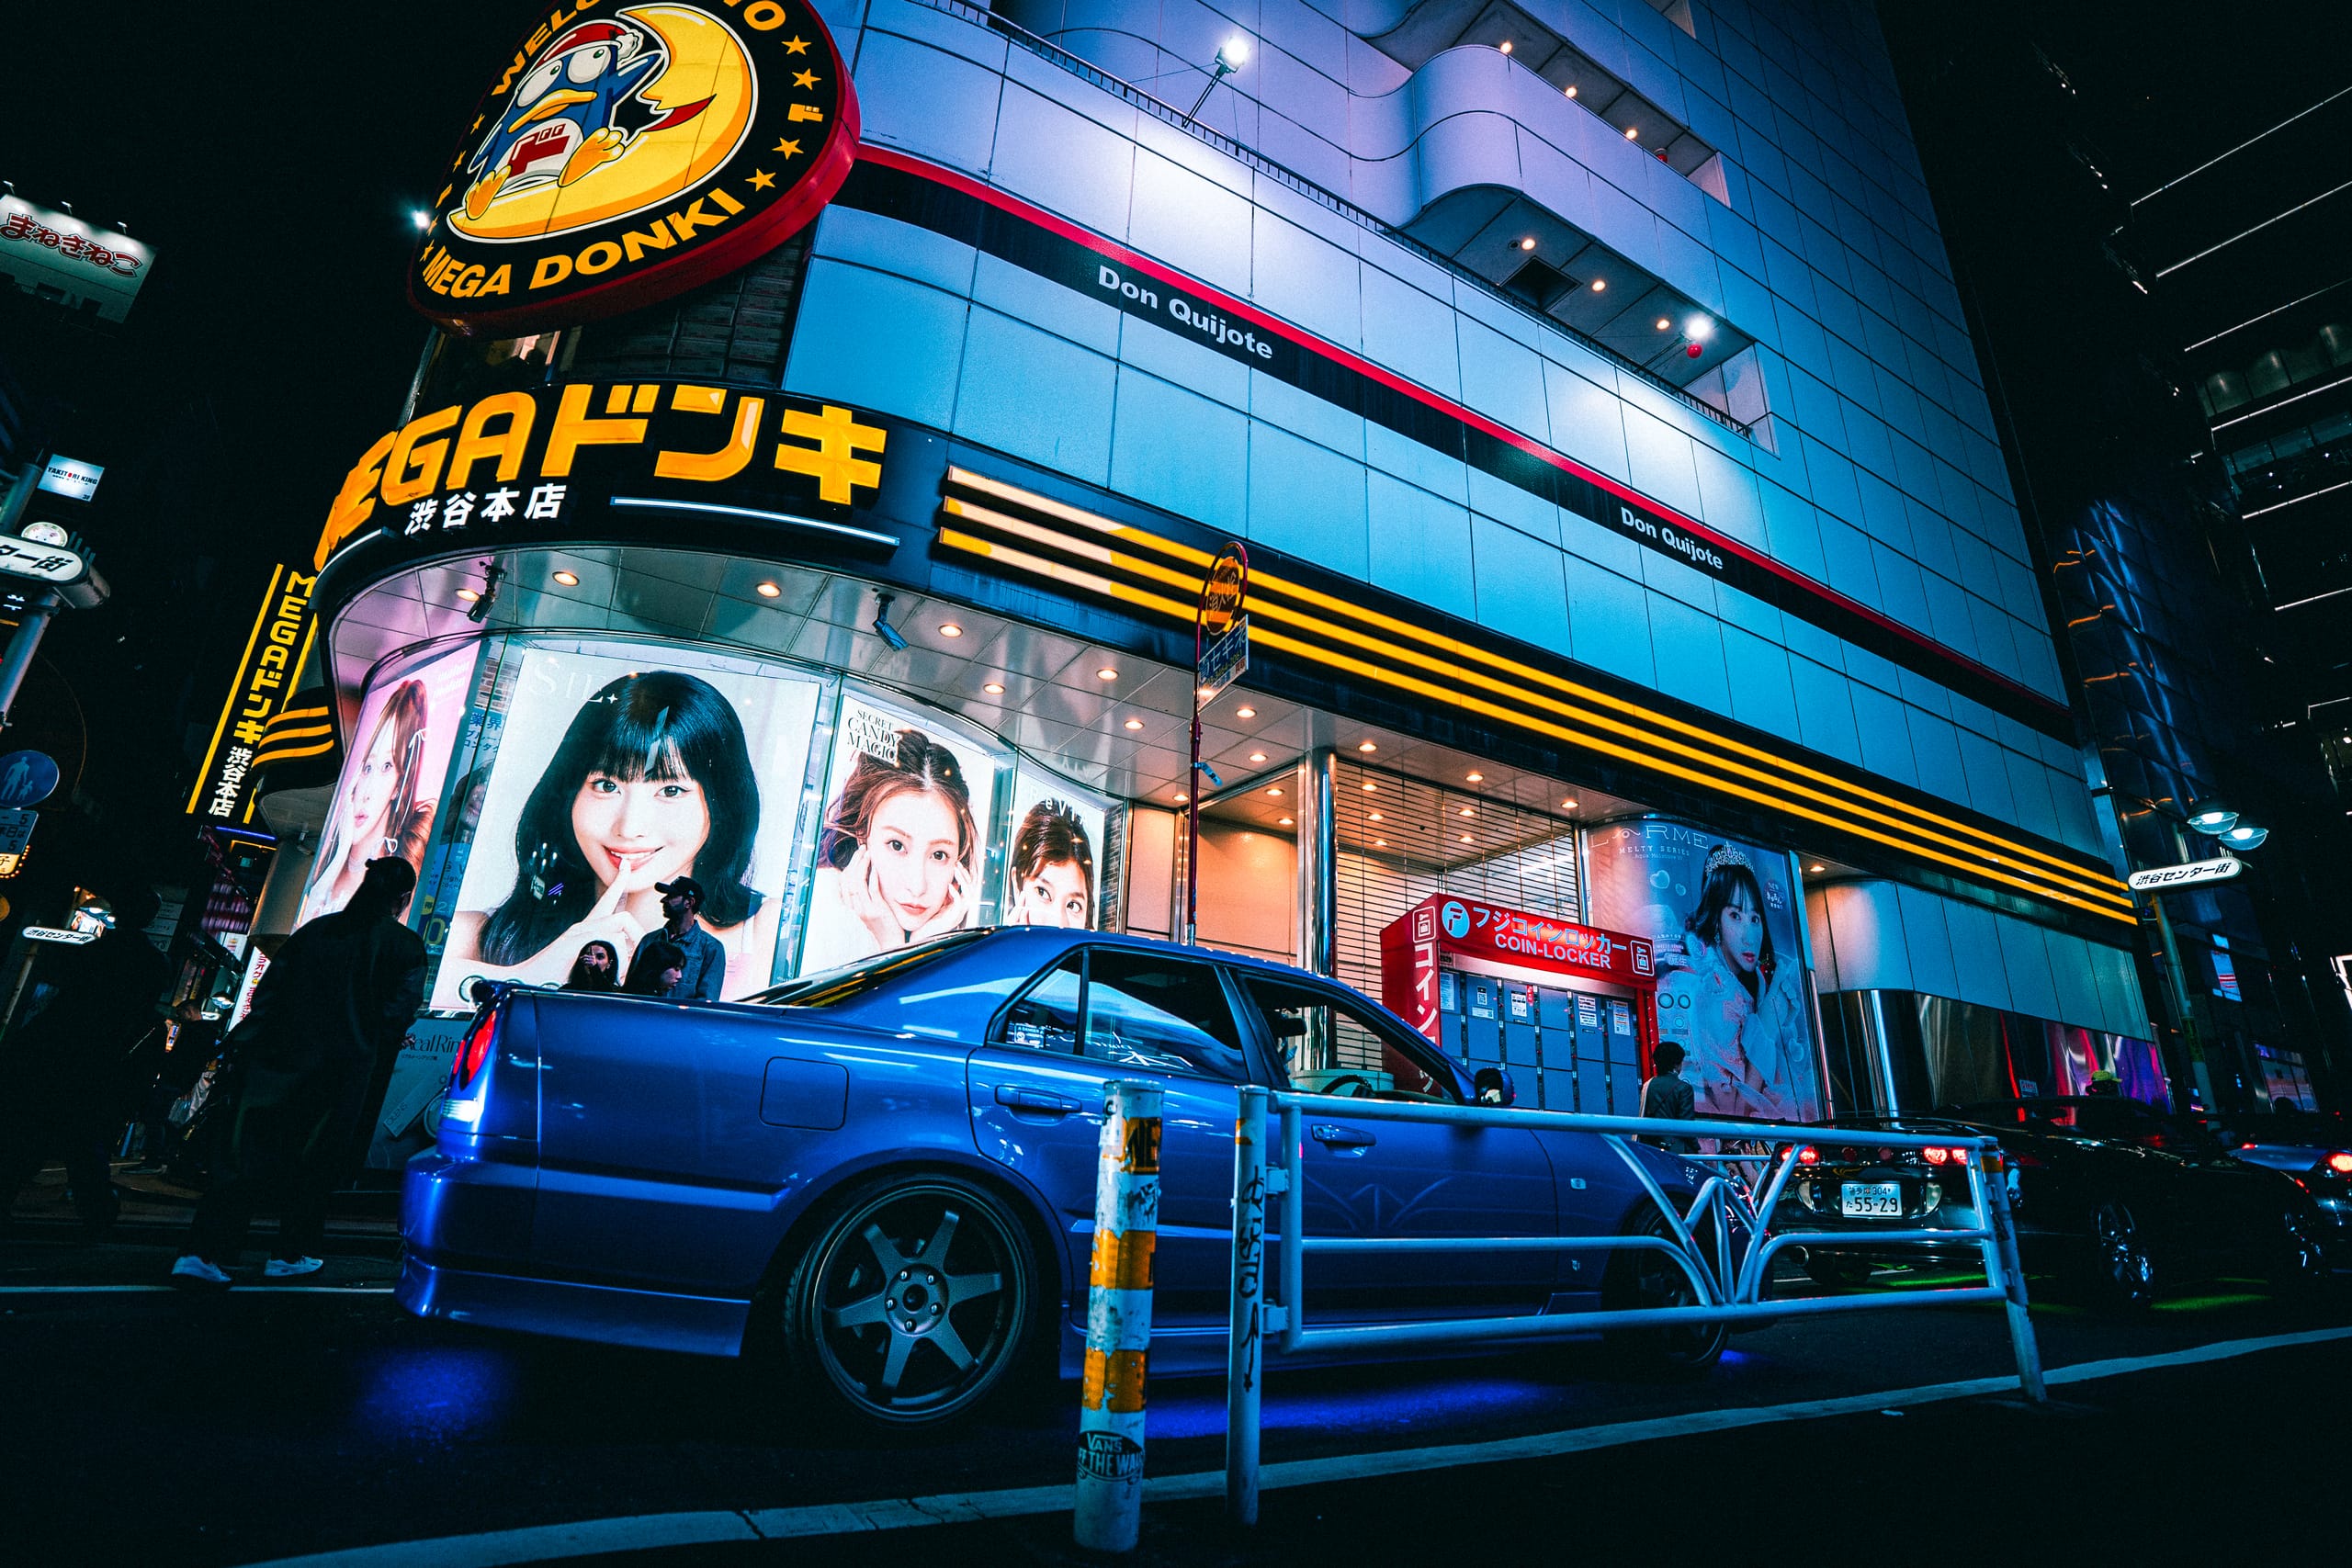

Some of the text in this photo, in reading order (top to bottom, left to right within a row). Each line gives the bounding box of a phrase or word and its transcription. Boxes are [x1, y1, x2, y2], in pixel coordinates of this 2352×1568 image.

[0, 212, 142, 277] まねきねこ
[421, 187, 746, 299] MEGA DONKI
[1098, 265, 1273, 359] Don Quijote
[81, 475, 98, 485] KING
[404, 482, 568, 536] 渋谷本店
[1621, 506, 1724, 570] Don Quijote
[233, 570, 317, 745] MEGAドンキ
[847, 716, 900, 748] CANDY
[857, 709, 892, 731] SECRET
[846, 731, 897, 763] MAGIC
[208, 746, 253, 818] 渋谷本店
[1619, 845, 1654, 854] MELTY
[2136, 863, 2232, 886] 渋谷センター街
[1473, 906, 1627, 954] フジコインロッカー
[1494, 933, 1611, 970] COIN-LOCKER
[1854, 1196, 1899, 1213] 55-29
[1087, 1432, 1123, 1453] VANS
[1087, 1450, 1114, 1477] THE
